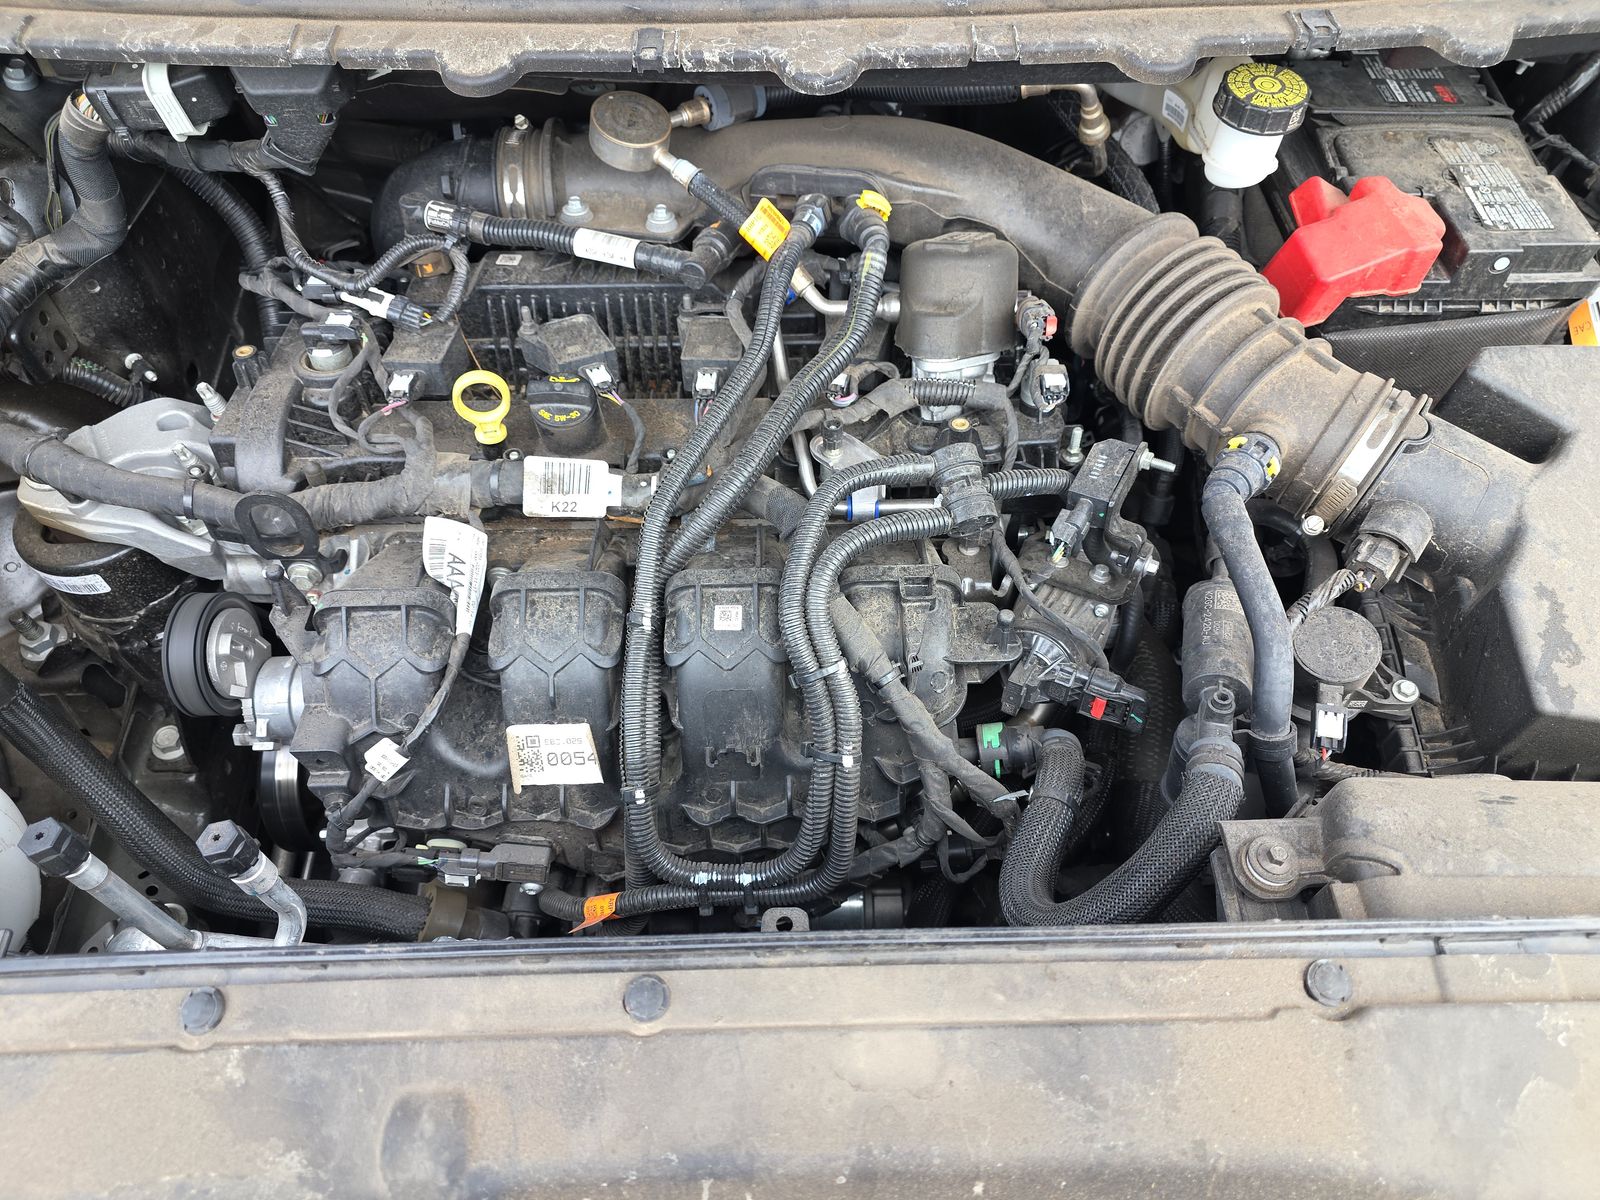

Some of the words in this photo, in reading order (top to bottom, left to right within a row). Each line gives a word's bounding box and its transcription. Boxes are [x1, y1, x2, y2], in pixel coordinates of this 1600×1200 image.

[538, 409, 553, 420] SAE
[554, 410, 581, 422] 5W-30
[551, 501, 578, 513] K22
[546, 751, 598, 767] 0054
